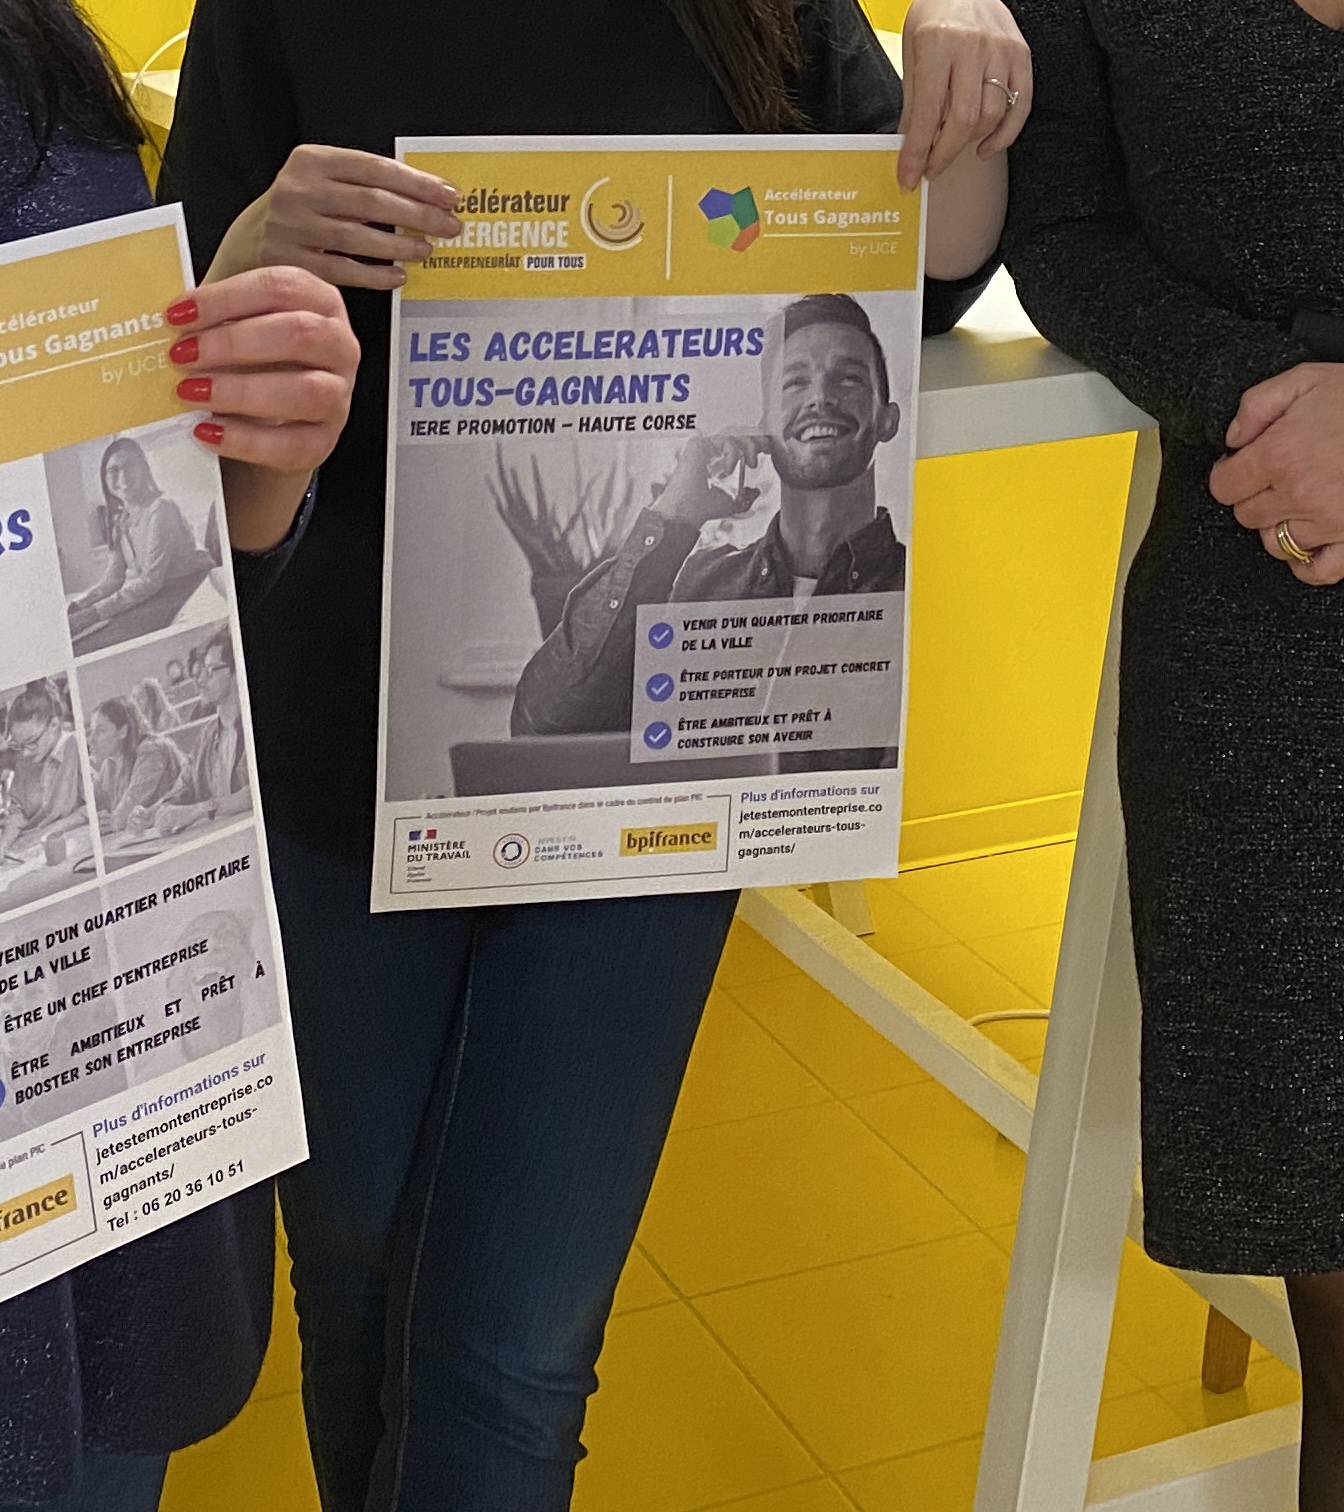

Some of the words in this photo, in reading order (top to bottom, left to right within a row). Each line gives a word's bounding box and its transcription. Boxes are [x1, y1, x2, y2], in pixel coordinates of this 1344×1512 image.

[453, 188, 570, 214] célérateur
[764, 188, 858, 201] Accélérateur
[764, 210, 808, 225] Tous
[813, 209, 900, 228] Gagnants
[850, 242, 867, 258] by
[527, 256, 554, 269] POUR
[558, 256, 584, 268] TOUS
[44, 311, 164, 353] Gagnants
[409, 331, 471, 363] LES
[483, 327, 765, 362] ACCELERATEURS
[101, 366, 122, 385] by
[128, 353, 168, 376] UCE
[457, 418, 556, 435] PROMOTION
[578, 415, 637, 433] HAUTE
[642, 414, 697, 431] CORSE
[683, 619, 717, 631] VENIR
[751, 613, 809, 627] QUARTIER
[812, 609, 884, 625] PRIORITAIRE
[682, 640, 697, 651] DE
[701, 638, 717, 650] LA
[721, 637, 753, 649] VILLE
[712, 667, 763, 681] PORTEUR
[795, 663, 838, 676] PROJET
[841, 661, 891, 673] CONCRET
[710, 714, 770, 729] AMBITIEUX
[773, 713, 788, 724] ET
[677, 735, 744, 749] CONSTRUIRE
[748, 732, 769, 744] SON
[773, 730, 813, 742] AVENIR
[741, 791, 767, 803] Plus
[771, 785, 857, 801] d'informations
[860, 785, 880, 795] sur
[739, 803, 882, 824] jetestemontentreprise.co
[407, 840, 466, 853] MINISTÈRE
[626, 830, 712, 852] bpifrance
[738, 843, 796, 859] gagnants/
[407, 854, 423, 863] DU
[426, 850, 471, 861] TRAVAIL
[46, 923, 79, 950] D'UN
[83, 893, 158, 934] QUARTIER
[163, 855, 250, 904] PRIORITAIRE
[23, 966, 45, 985] LA
[49, 946, 91, 975] VILLE
[4, 1007, 43, 1033] ÊTRE
[47, 997, 67, 1016] UN
[71, 980, 109, 1007] CHEF
[113, 939, 209, 990] D'ENTREPRISE
[10, 1053, 50, 1081] ÊTRE
[70, 1015, 145, 1057] AMBITIEUX
[164, 999, 182, 1017] ET
[201, 975, 235, 1001] PRÊT
[15, 1067, 79, 1105] BOOSTER
[85, 1053, 112, 1076] SON
[117, 1016, 201, 1063] ENTREPRISE
[92, 1115, 128, 1138] Plus
[132, 1065, 239, 1121] d'informations
[243, 1052, 266, 1072] sur
[96, 1074, 273, 1166] jetestemontentreprise.co
[100, 1106, 258, 1185] m/accelerateurs-tous-
[103, 1163, 175, 1210] gagnants/
[107, 1212, 129, 1232] Tel
[142, 1198, 160, 1217] 06
[165, 1189, 181, 1206] 20
[186, 1179, 203, 1197] 36
[207, 1169, 224, 1187] 10
[228, 1159, 244, 1178] 51
